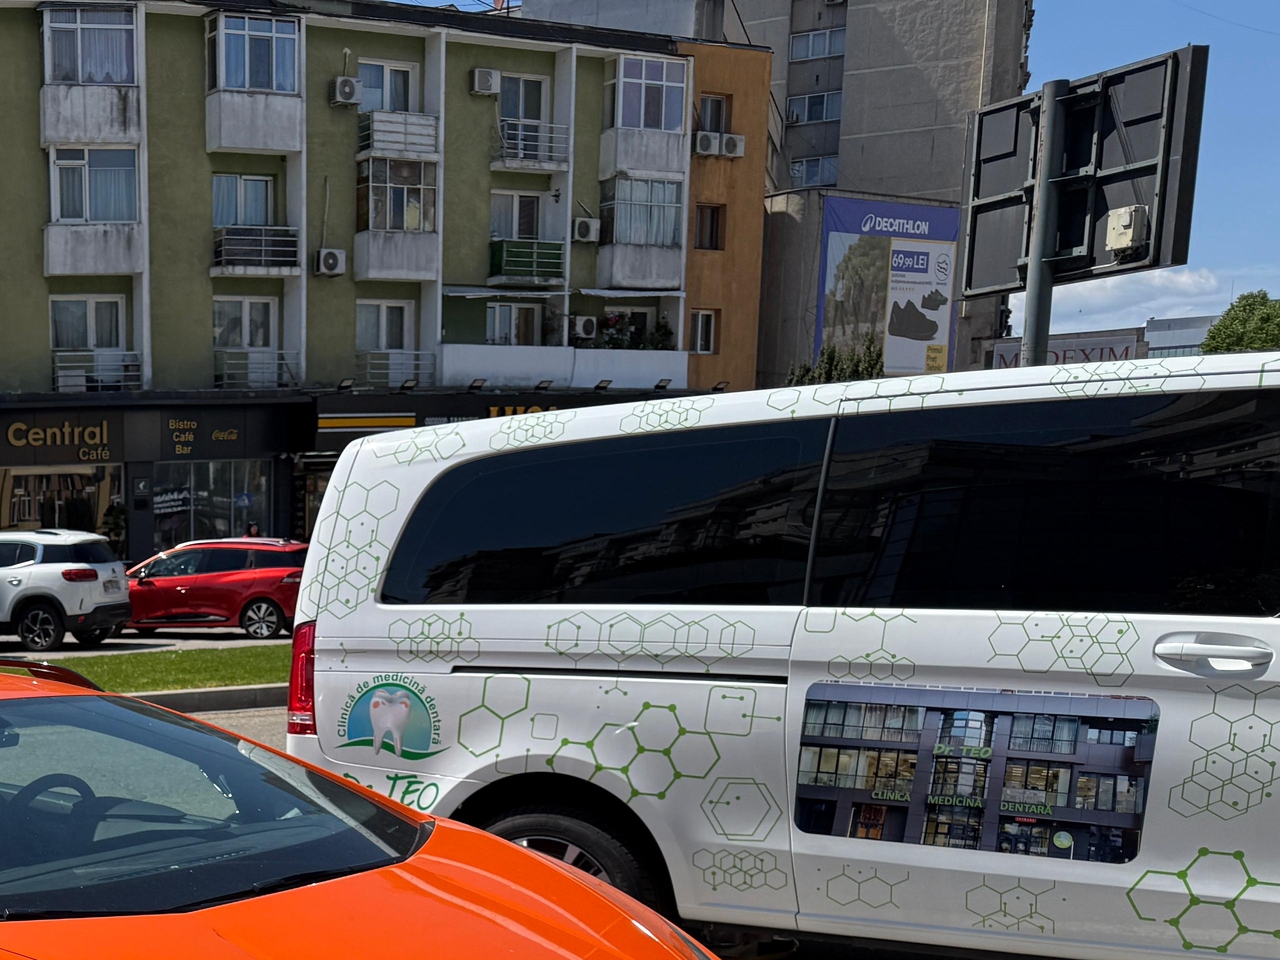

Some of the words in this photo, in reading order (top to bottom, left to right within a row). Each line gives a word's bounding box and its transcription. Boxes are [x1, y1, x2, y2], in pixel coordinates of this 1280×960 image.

[875, 217, 929, 234] DECATHLON
[892, 253, 913, 269] 69,99
[914, 255, 927, 268] LEI
[997, 346, 1131, 369] MDEXIM
[168, 419, 197, 430] Bistro
[7, 420, 108, 447] Central
[172, 431, 194, 443] Café
[78, 447, 110, 461] Café
[175, 444, 192, 455] Bar
[337, 693, 356, 738] Clinică
[356, 680, 370, 695] de
[372, 672, 427, 695] medicină
[425, 695, 442, 746] dentară
[933, 743, 954, 756] Dr.
[960, 745, 993, 759] TEO
[386, 773, 440, 811] TEO
